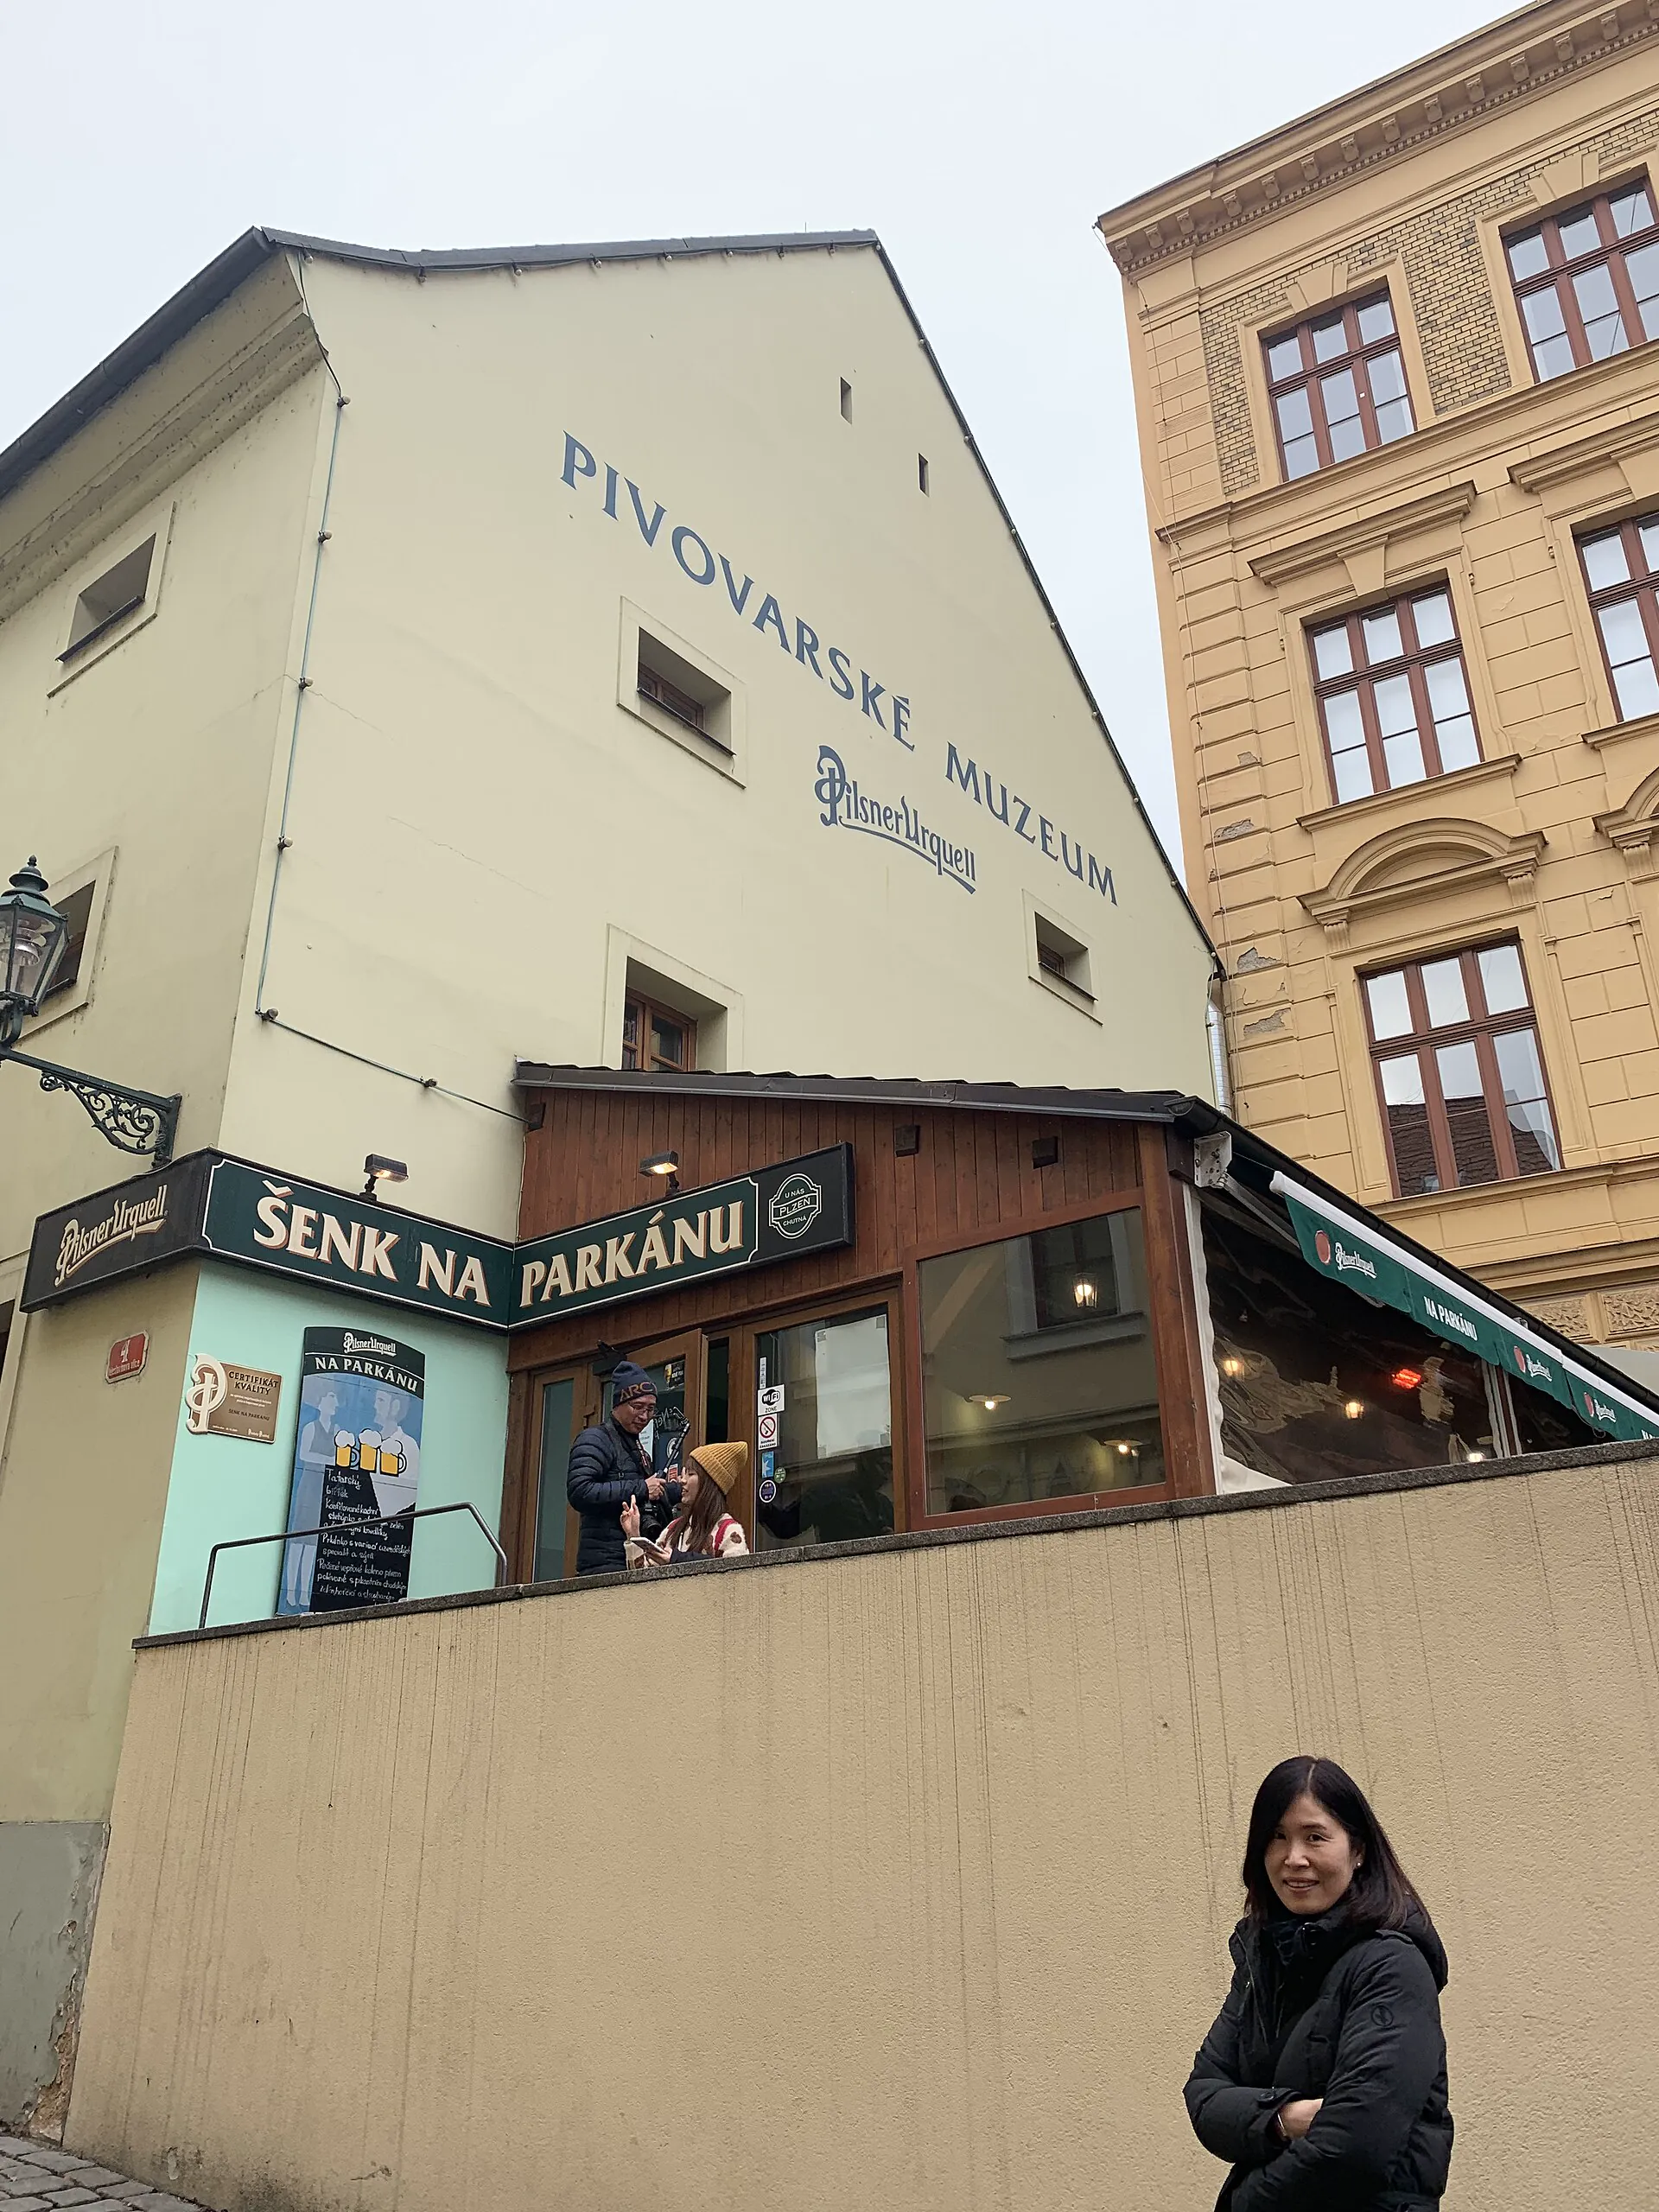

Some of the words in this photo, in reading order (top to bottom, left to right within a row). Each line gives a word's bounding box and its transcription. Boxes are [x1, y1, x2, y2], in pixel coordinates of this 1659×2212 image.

[560, 429, 915, 752] PIVOVARSKÉ
[944, 741, 1118, 906] MUZEUM
[815, 745, 903, 836] Pilsner
[900, 795, 976, 882] Urquell
[791, 1188, 805, 1197] NÁS
[783, 1215, 807, 1226] CHUTNÁ
[54, 1217, 114, 1287] Pilsner
[111, 1185, 168, 1242] Urquell
[253, 1179, 401, 1281] ŠENK
[416, 1242, 491, 1306] NA
[519, 1200, 745, 1308] PARKÁNU
[1424, 1295, 1439, 1320] NA
[120, 1339, 130, 1363] 4
[343, 1332, 371, 1354] Pilsner
[370, 1336, 396, 1354] Urquell
[315, 1357, 339, 1370] NA
[344, 1358, 418, 1392] PARKÁNU
[235, 1381, 271, 1395] KVALITY
